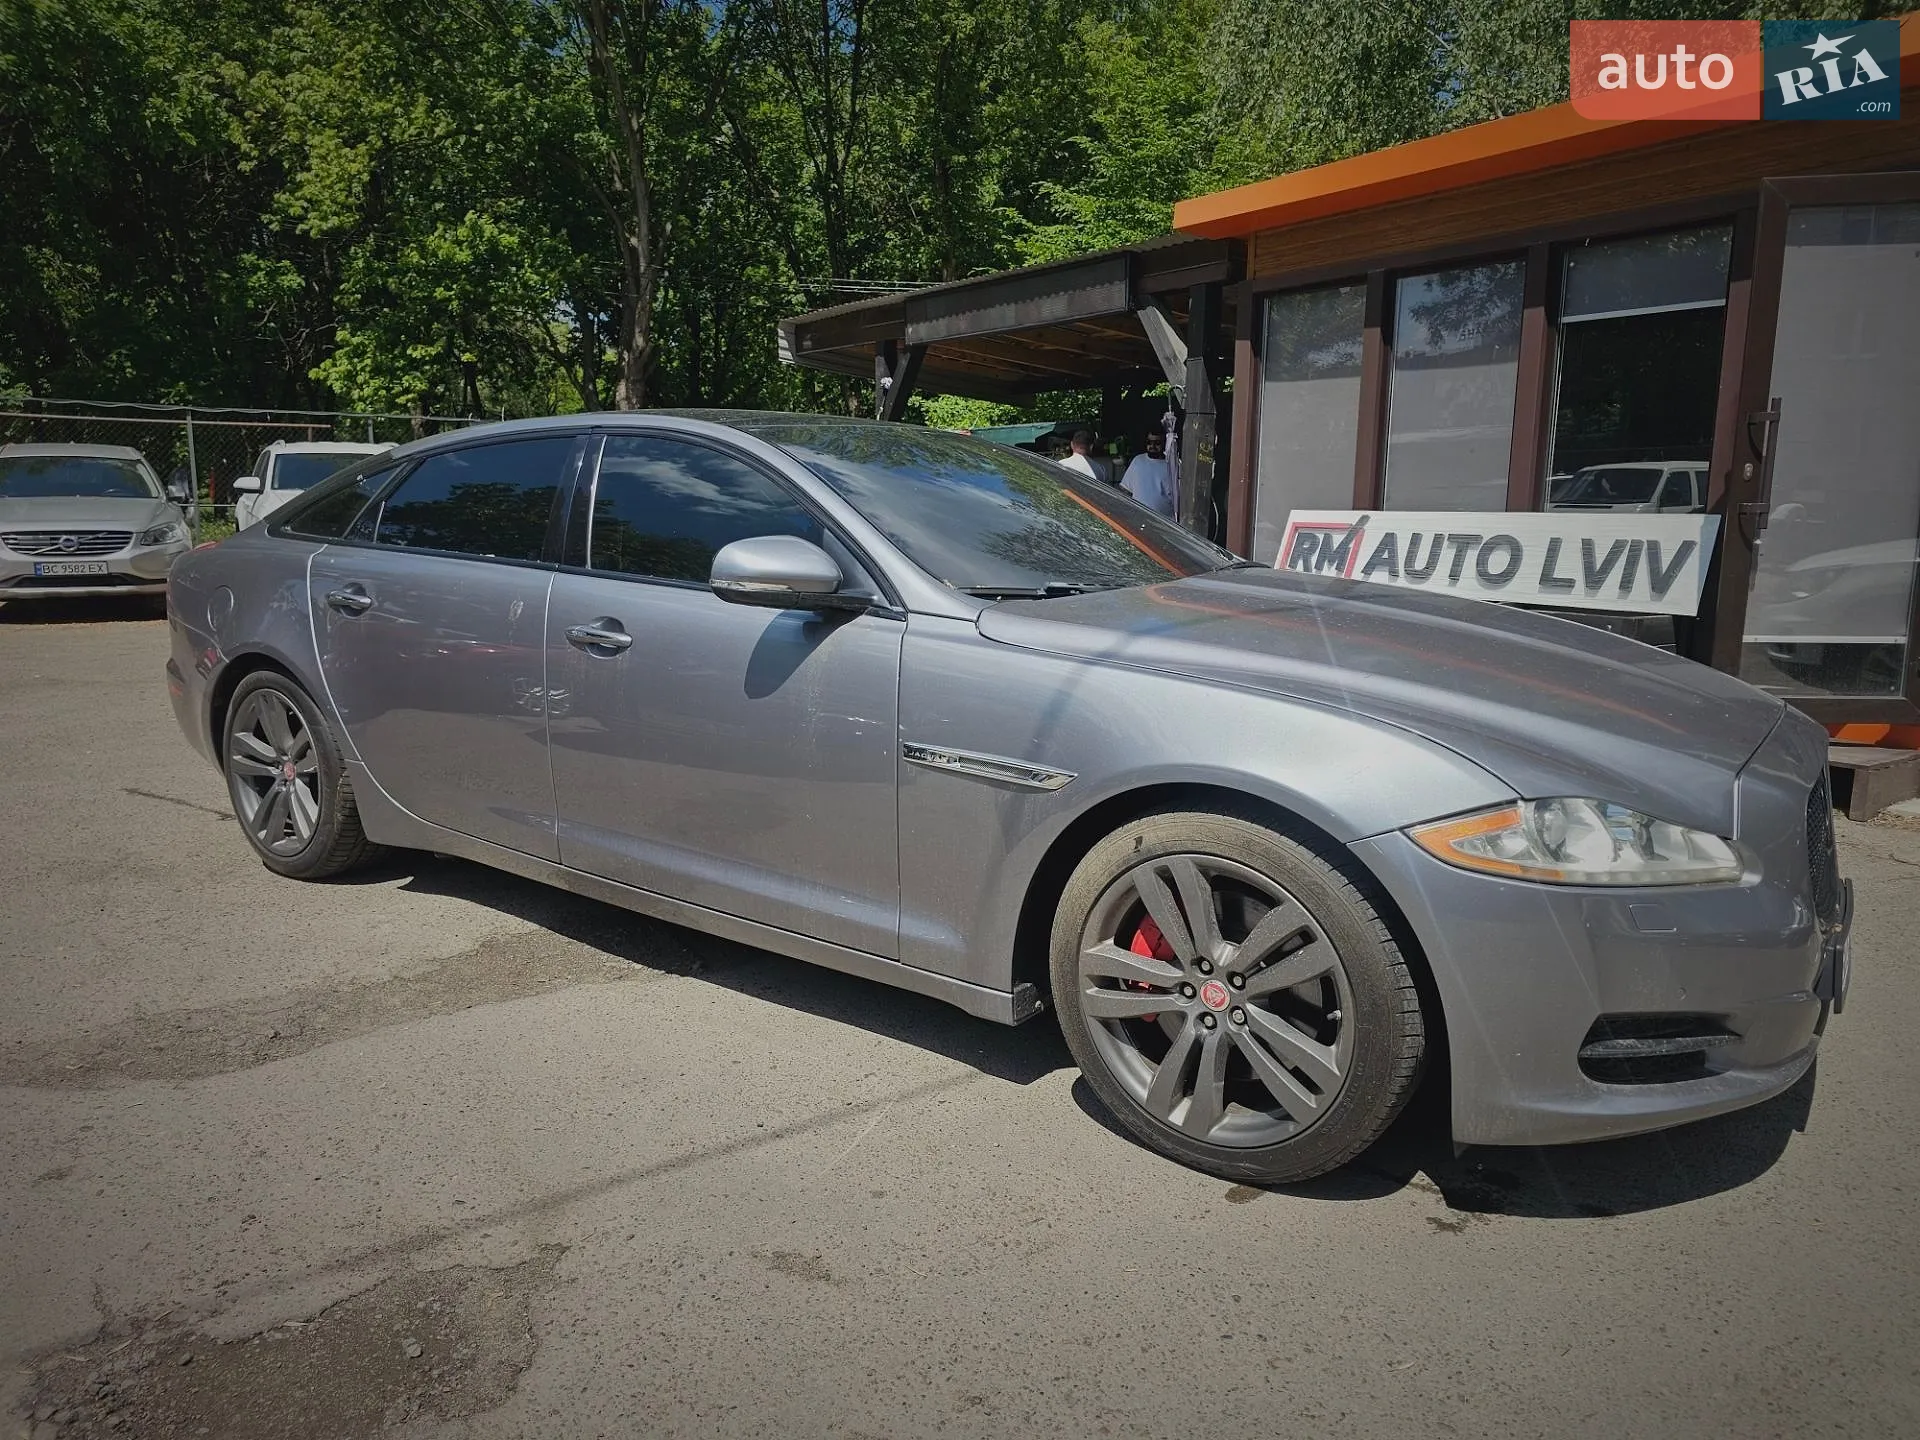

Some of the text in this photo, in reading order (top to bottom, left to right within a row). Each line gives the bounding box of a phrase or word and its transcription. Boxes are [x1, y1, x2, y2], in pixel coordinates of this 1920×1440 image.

[43, 564, 104, 574] BC 9582 EX
[1288, 515, 1698, 601] RM AUTO LVIV
